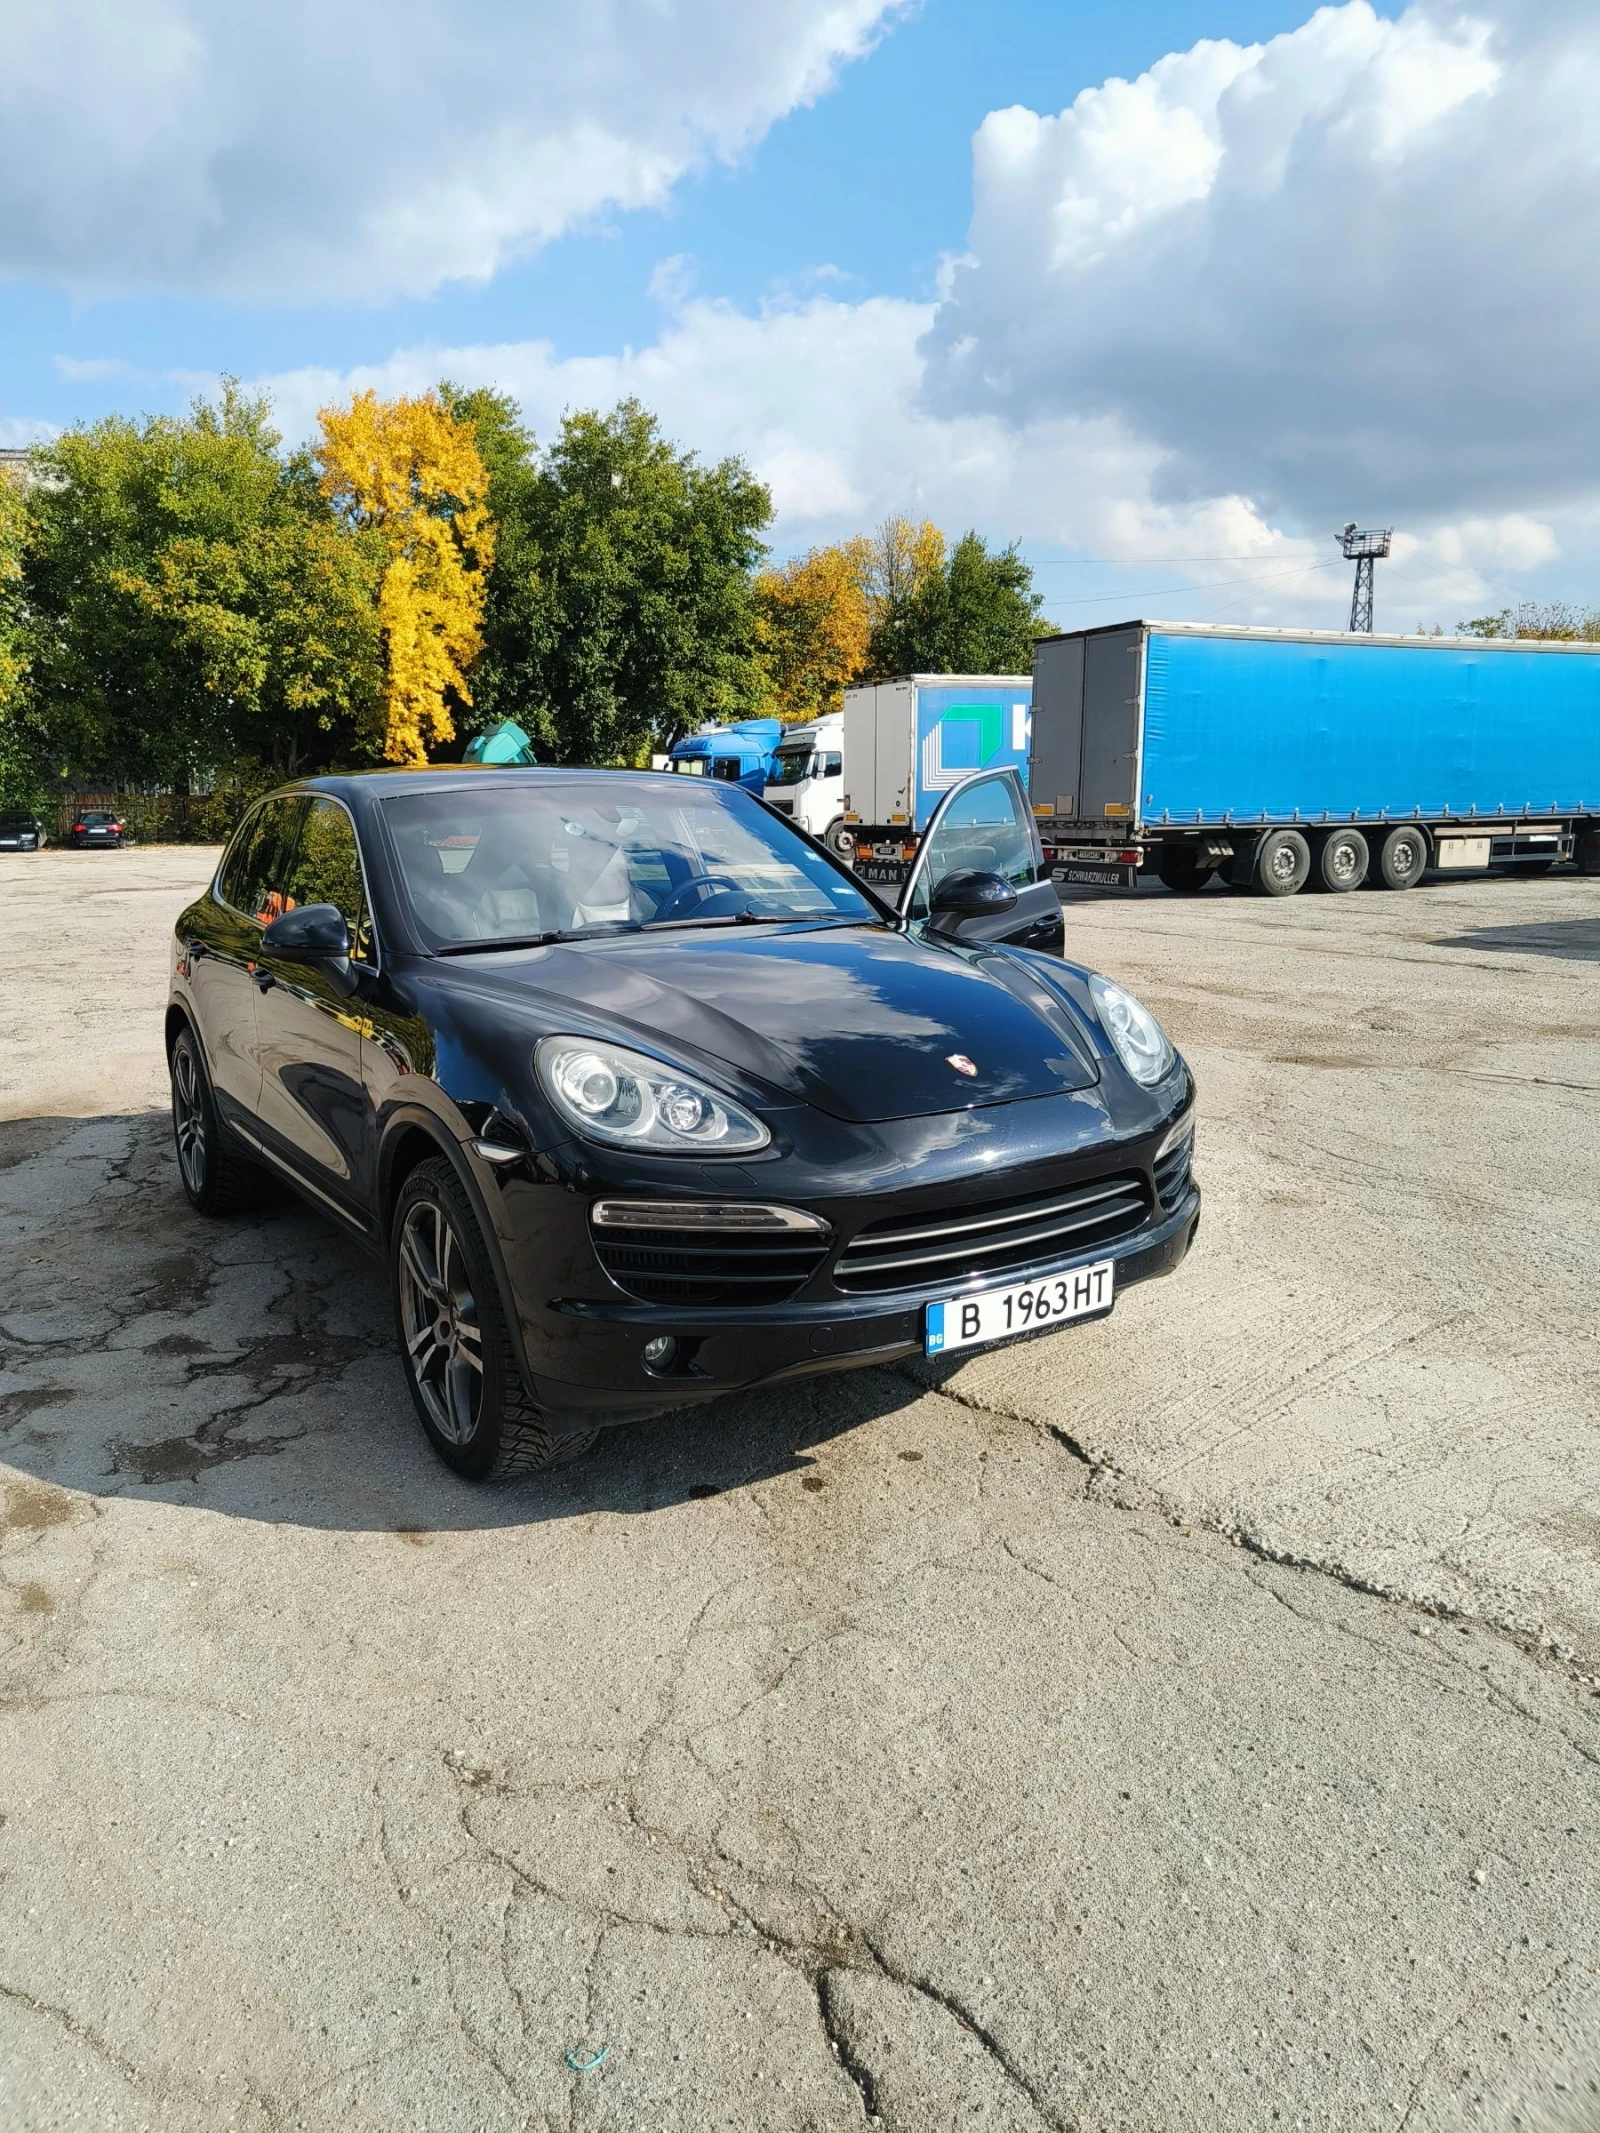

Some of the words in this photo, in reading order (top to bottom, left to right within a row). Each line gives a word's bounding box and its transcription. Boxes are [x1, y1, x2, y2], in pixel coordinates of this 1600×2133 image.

[868, 868, 897, 880] MAN
[961, 1303, 981, 1339] B
[928, 1334, 943, 1346] BG
